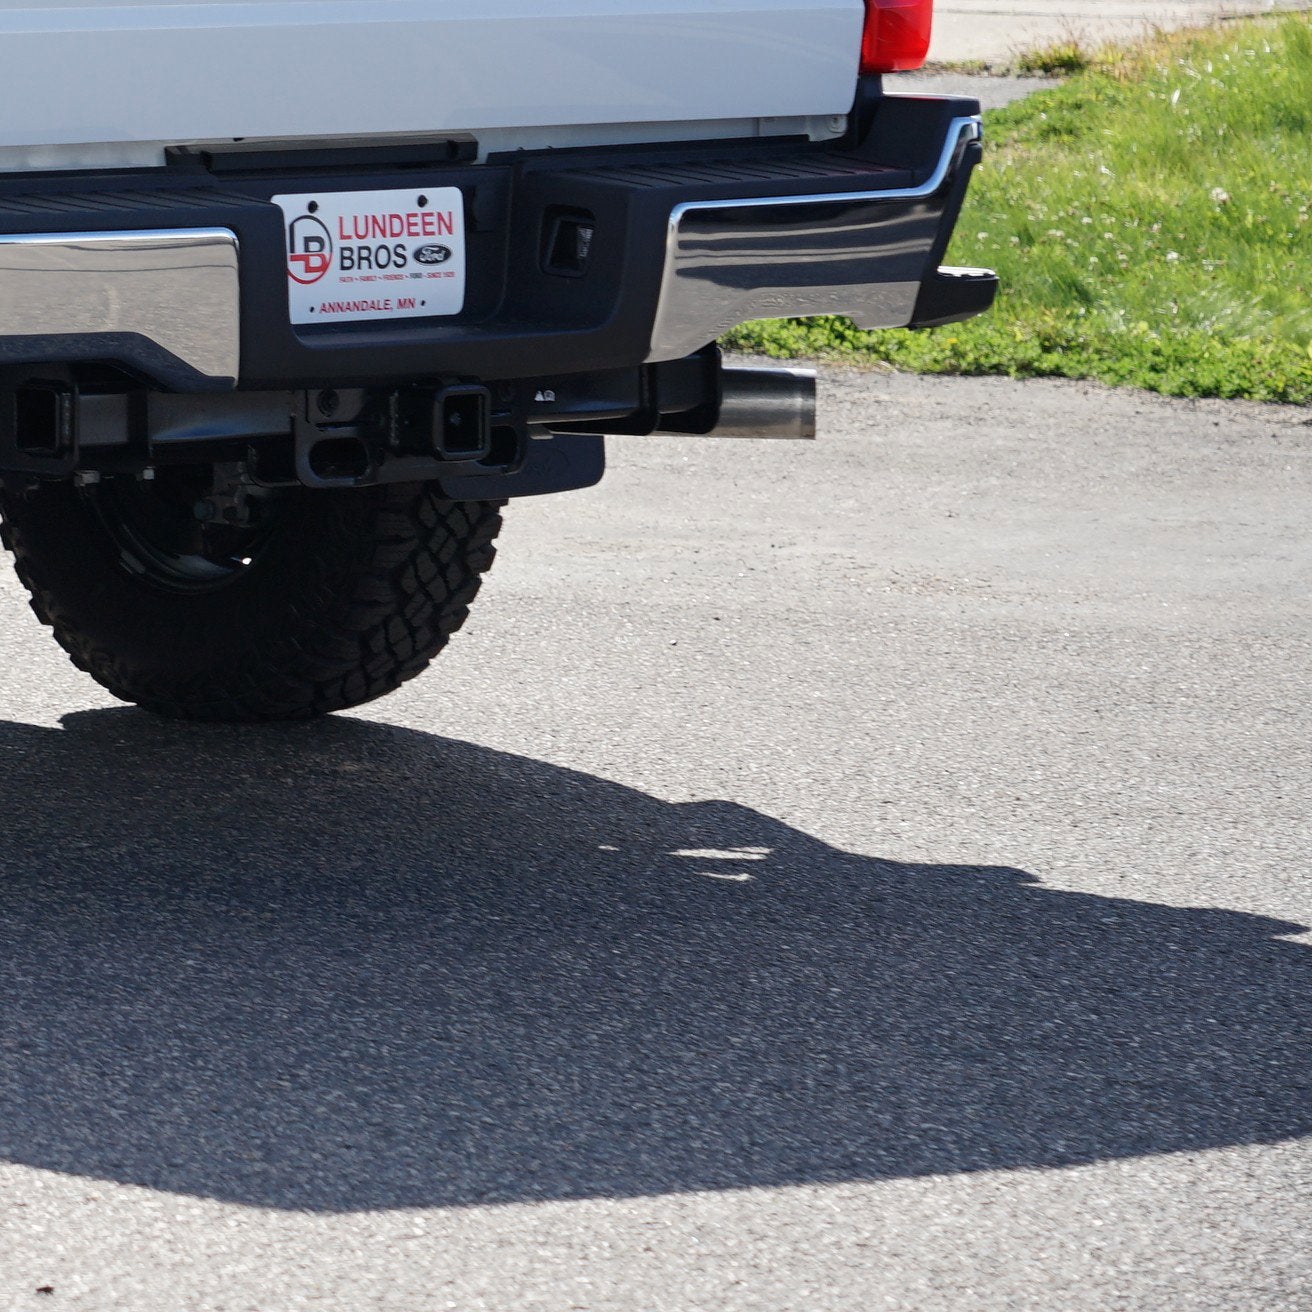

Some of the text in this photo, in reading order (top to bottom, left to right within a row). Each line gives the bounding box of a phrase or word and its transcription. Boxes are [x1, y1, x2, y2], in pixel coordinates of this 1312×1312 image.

[338, 211, 454, 240] LUNDEEN
[339, 244, 407, 271] BROS
[319, 297, 416, 314] ANNANDALE, MN
